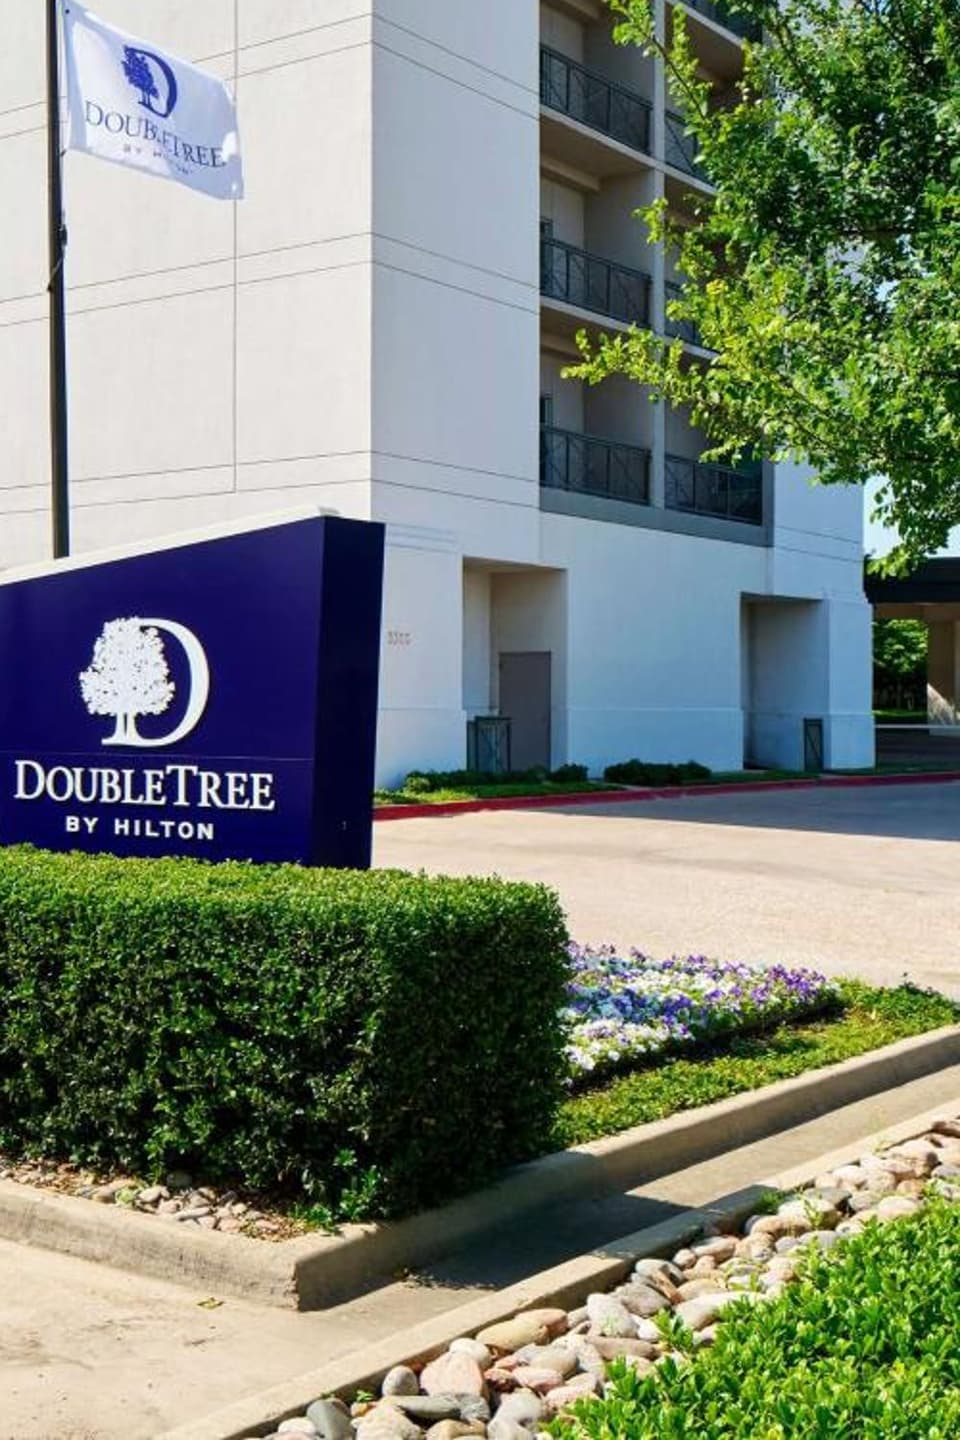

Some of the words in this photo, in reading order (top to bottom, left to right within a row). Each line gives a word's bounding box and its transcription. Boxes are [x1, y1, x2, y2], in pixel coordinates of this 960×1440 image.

[14, 760, 275, 811] DOUBLETREE
[66, 816, 98, 835] BY
[115, 821, 215, 841] HILTON
